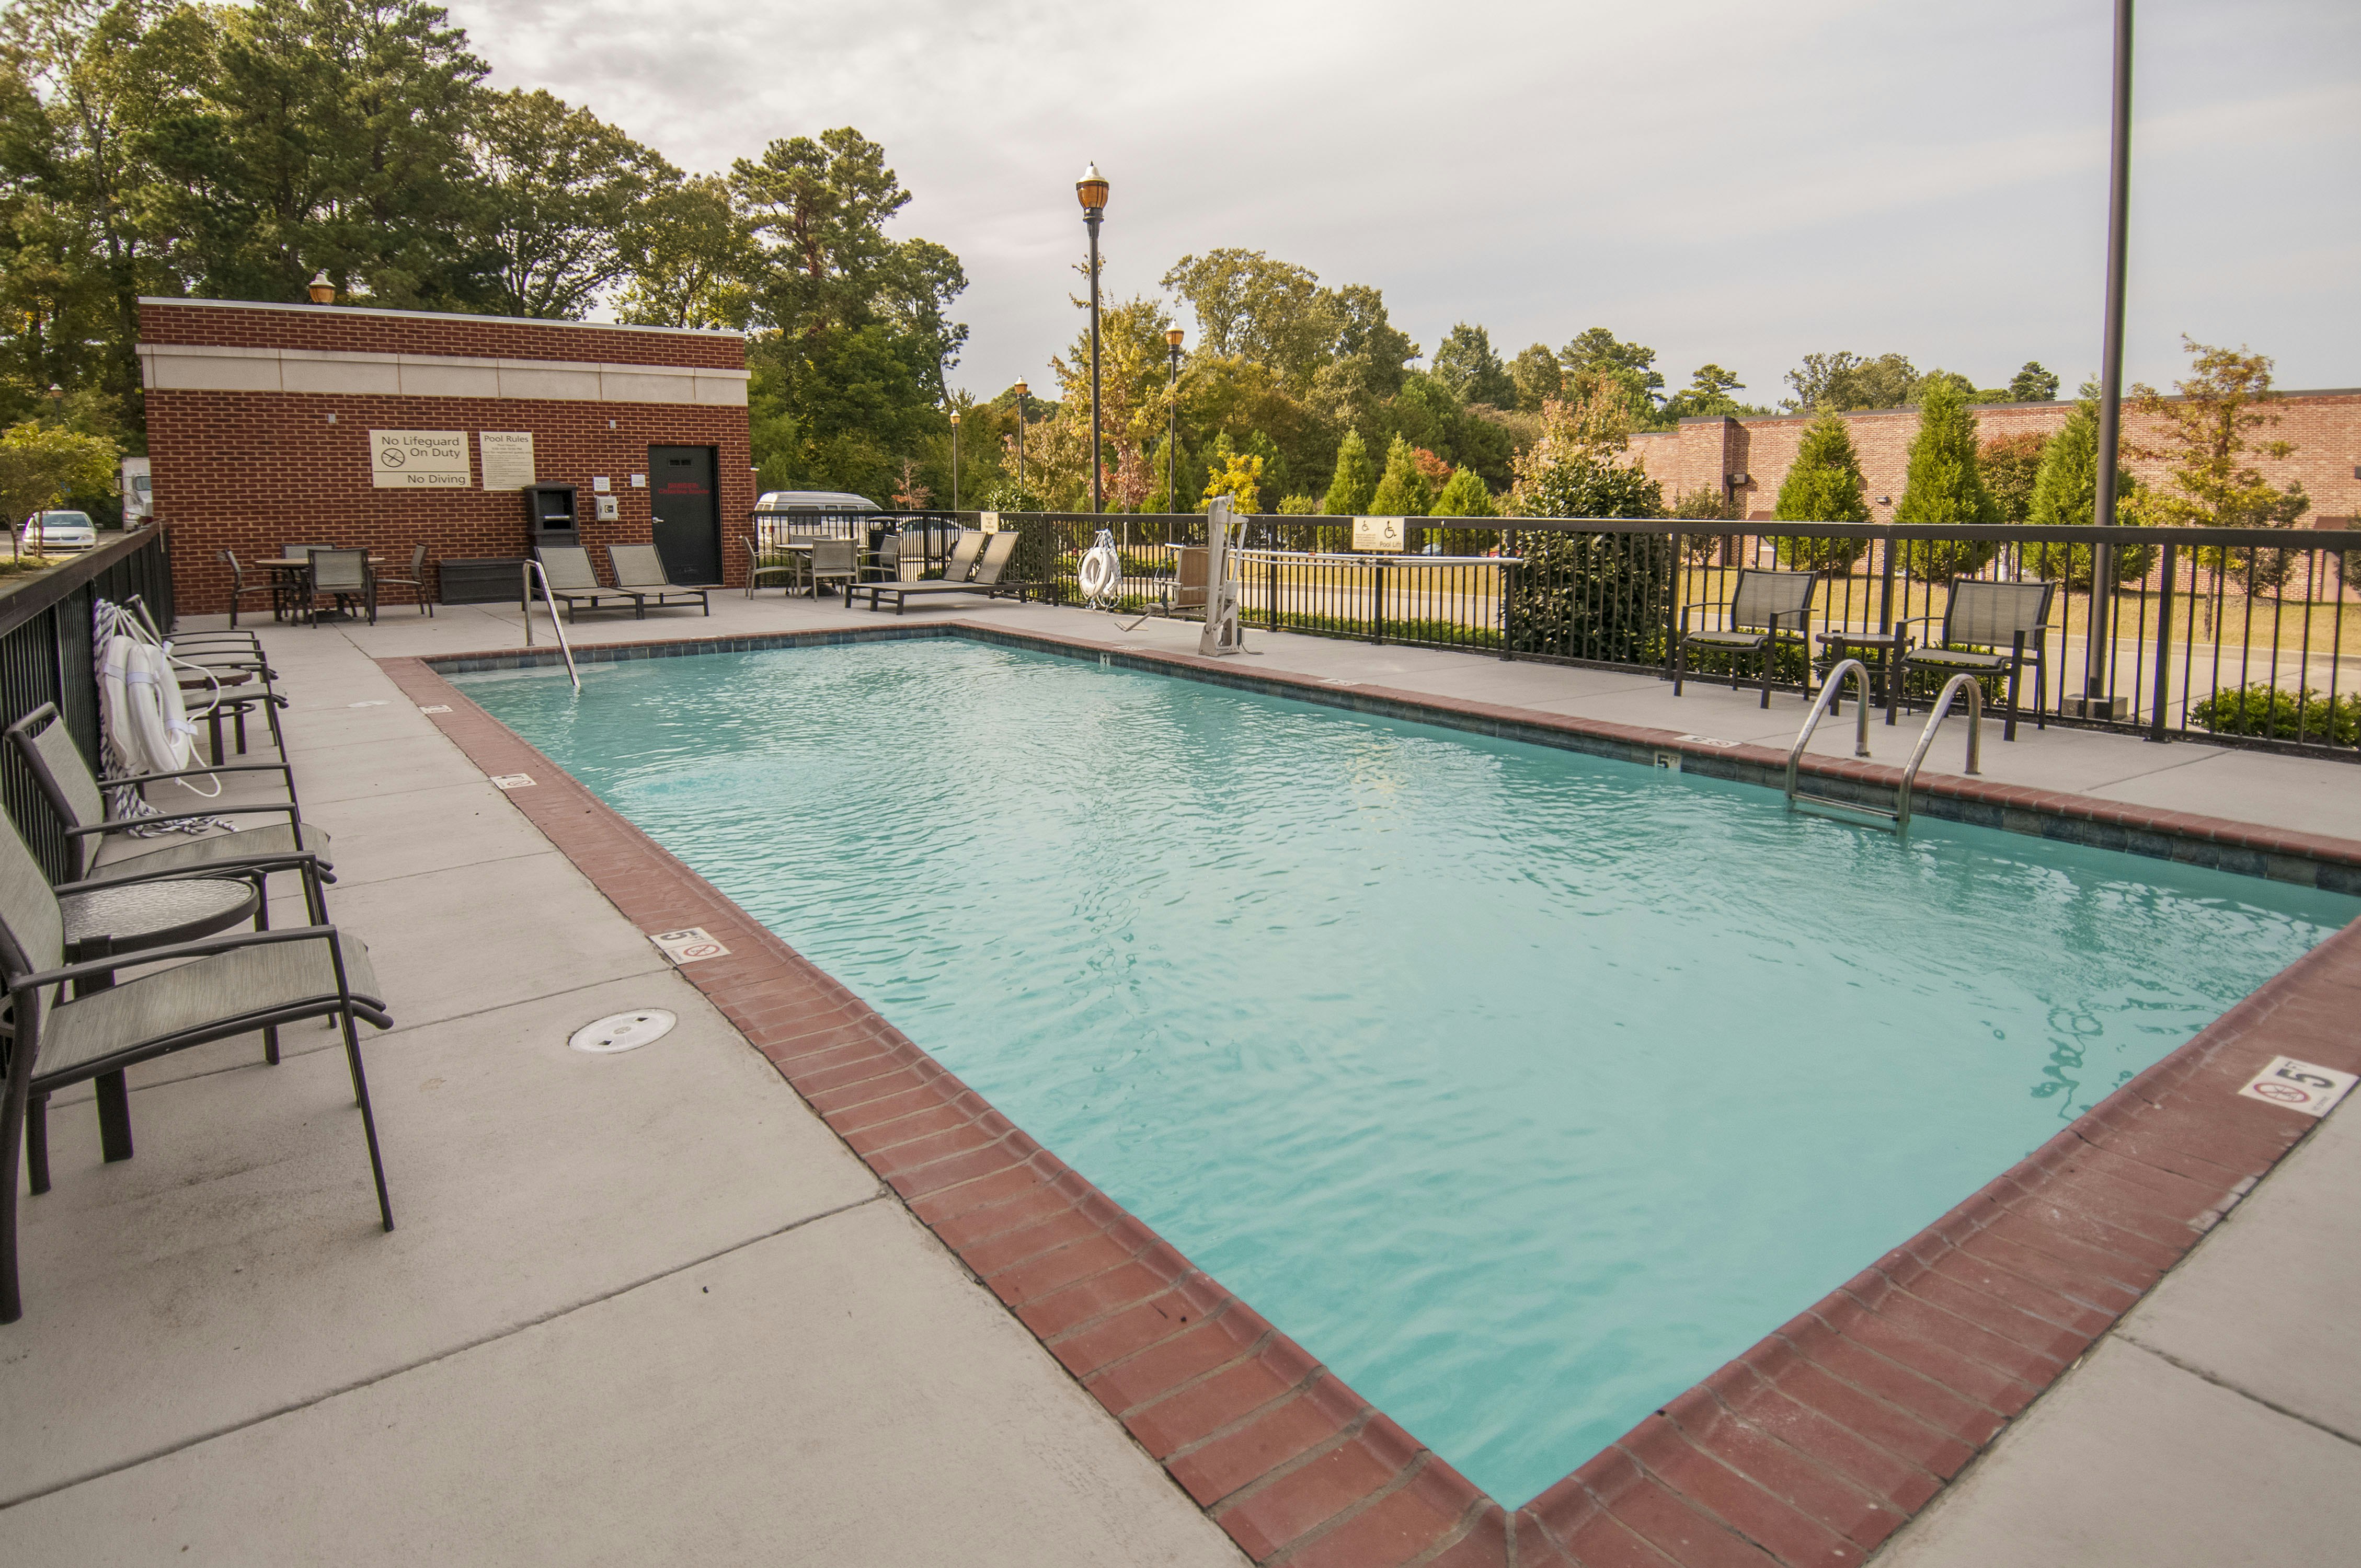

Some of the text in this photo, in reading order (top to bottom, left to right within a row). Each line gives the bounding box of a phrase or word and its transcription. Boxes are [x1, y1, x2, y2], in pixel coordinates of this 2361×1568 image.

[382, 436, 459, 447] No Lifeguard
[410, 448, 460, 459] On Duty
[408, 475, 465, 485] No Diving
[1658, 754, 1669, 768] 5
[660, 930, 697, 941] 5
[2276, 1068, 2336, 1089] 5
